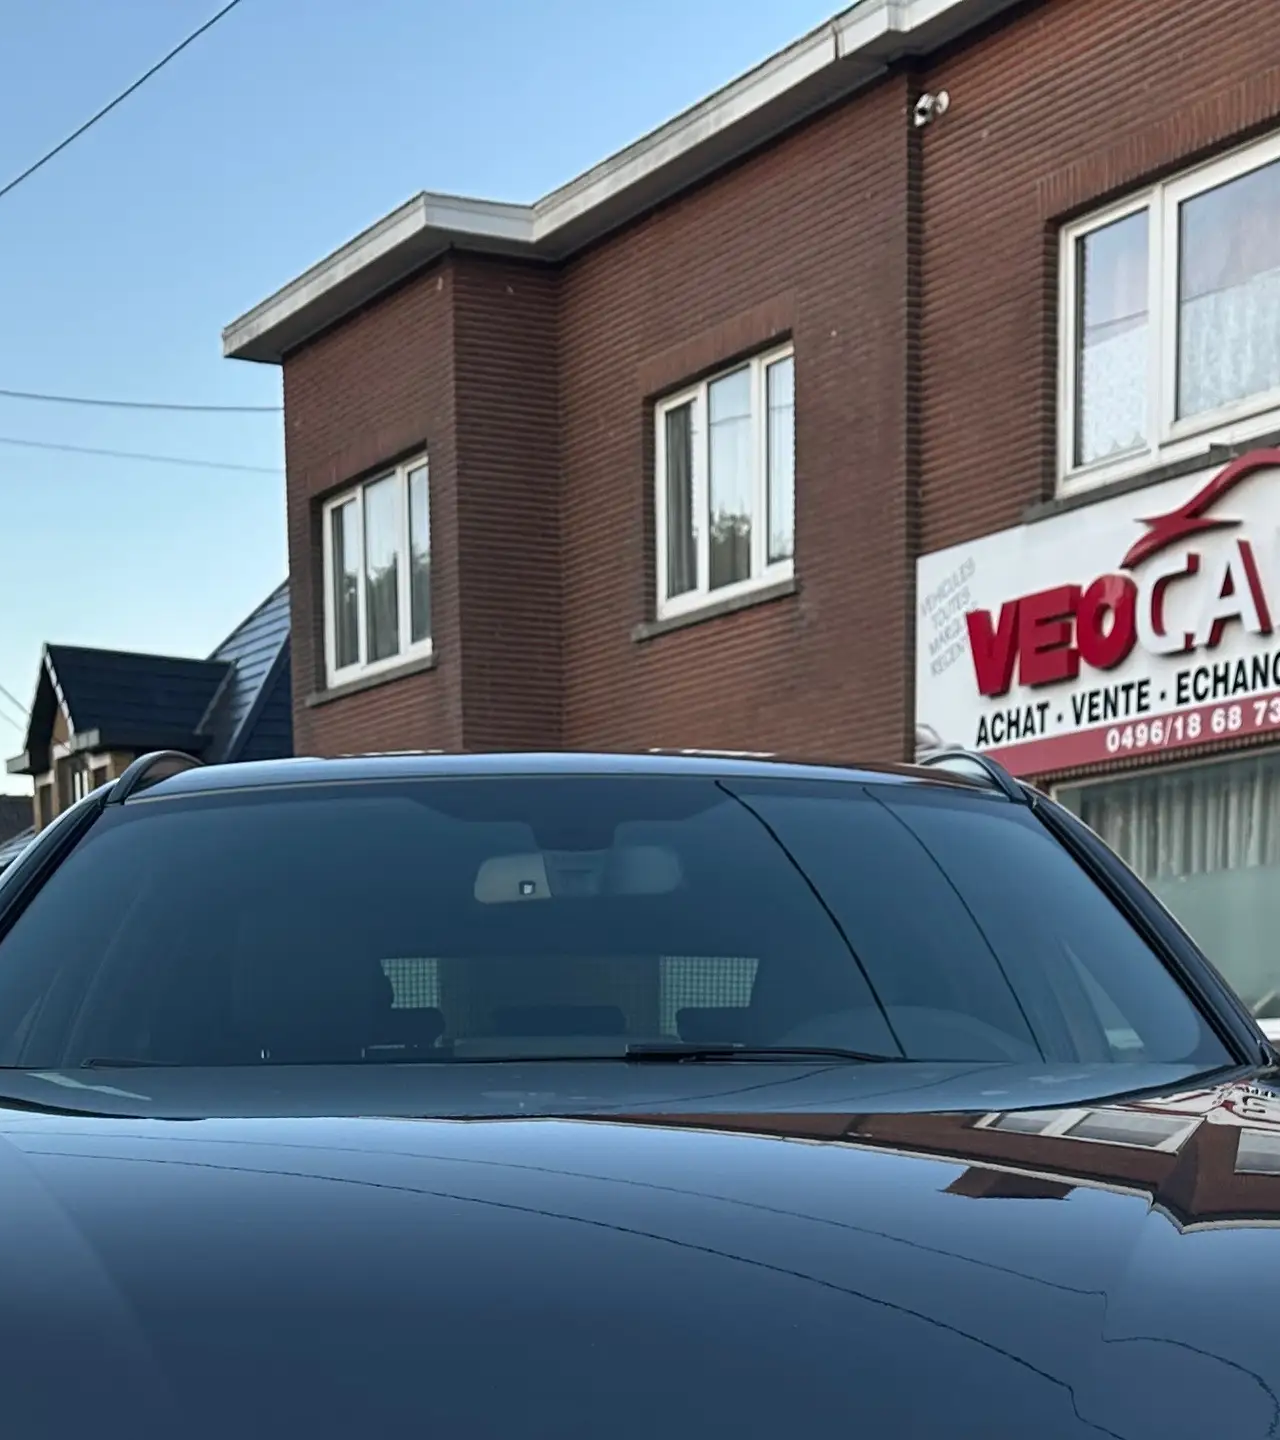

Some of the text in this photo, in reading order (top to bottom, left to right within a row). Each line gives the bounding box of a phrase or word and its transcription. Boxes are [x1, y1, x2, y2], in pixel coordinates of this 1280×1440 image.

[976, 701, 1051, 747] ACHAT
[1072, 678, 1152, 726] VENTE
[1105, 711, 1202, 753] 0496/18
[1210, 704, 1244, 735] 68
